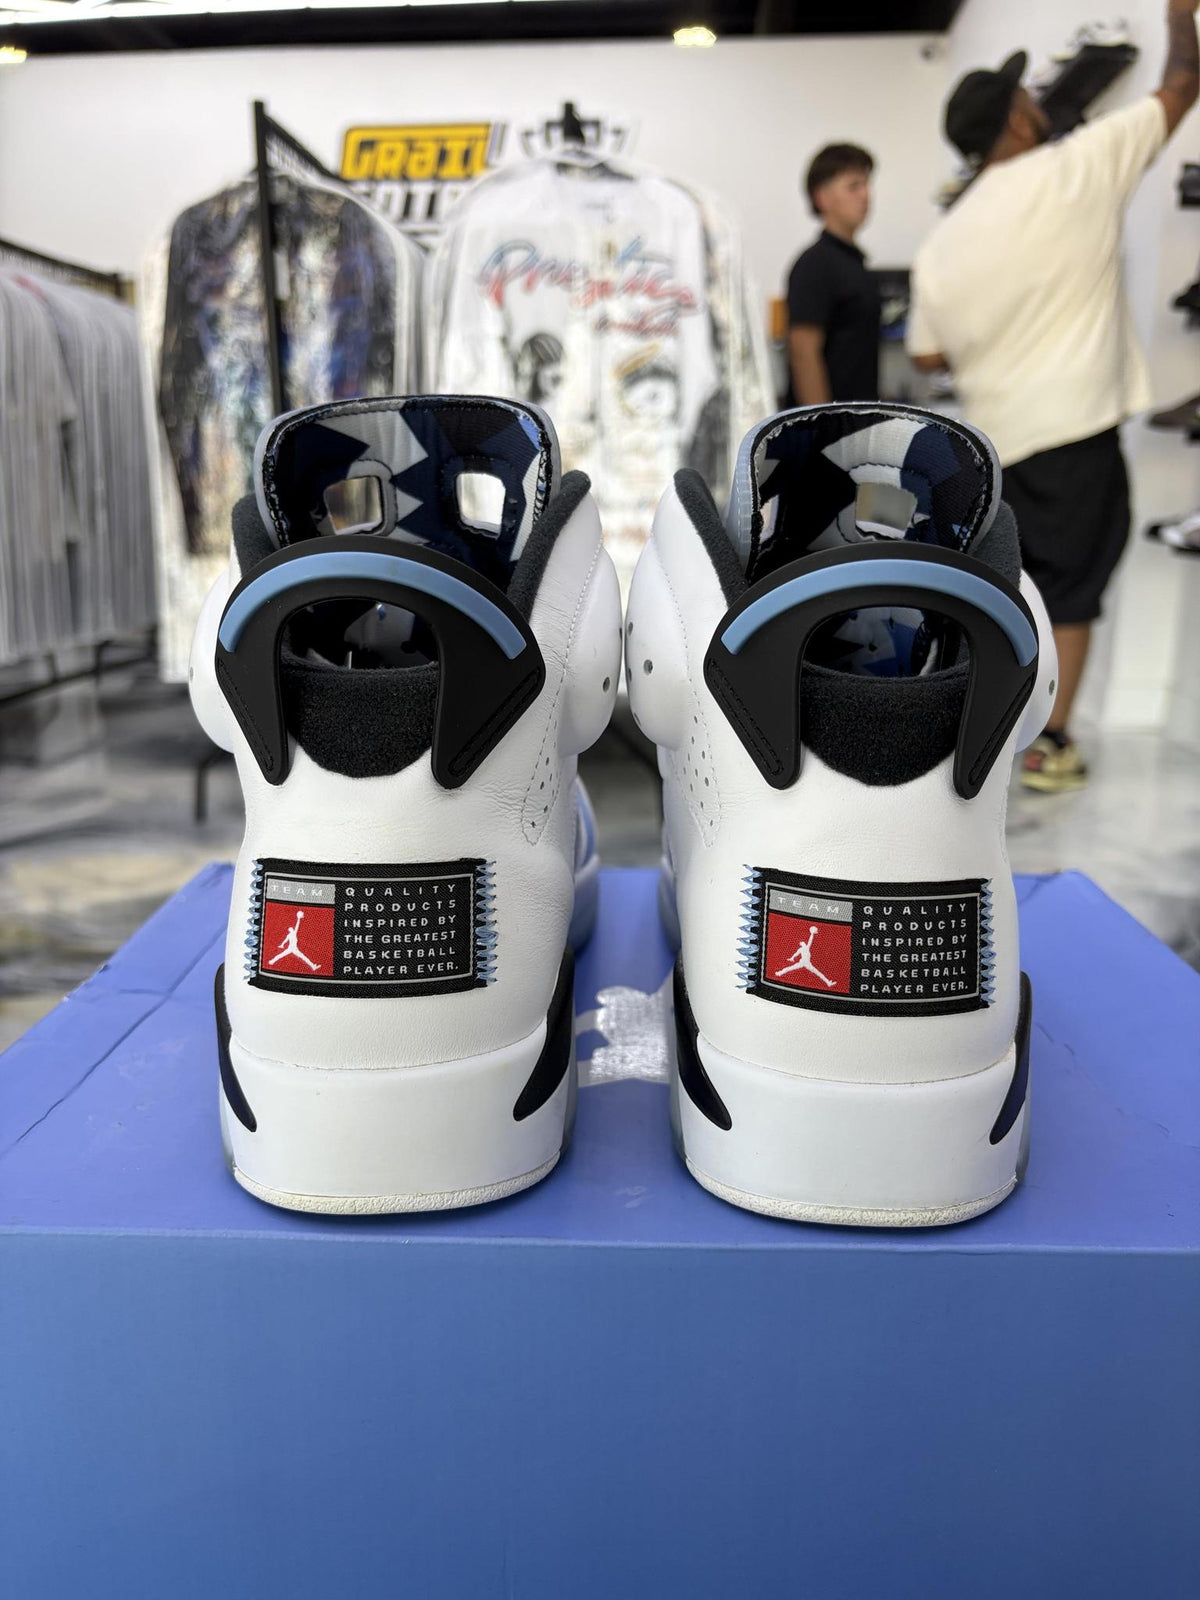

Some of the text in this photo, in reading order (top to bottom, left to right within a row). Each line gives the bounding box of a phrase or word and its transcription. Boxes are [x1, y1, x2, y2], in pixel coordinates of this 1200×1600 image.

[270, 884, 323, 898] TEAM
[345, 884, 456, 897] QUALITY
[344, 900, 456, 912] PRODUCTS
[777, 896, 839, 914] TEAM
[863, 903, 966, 916] QUALITY
[344, 915, 456, 928] INSPIRED BY
[862, 919, 967, 930] PRODUCTS
[344, 930, 456, 944] THE GREATEST
[862, 934, 967, 947] INSPIRED BY
[343, 947, 456, 959] BASKETBALL
[861, 950, 967, 963] THE GREATEST
[343, 962, 459, 975] PLAYER EVER.
[861, 966, 966, 978] BASKETBALL
[860, 982, 968, 994] PLAYER EVER.
